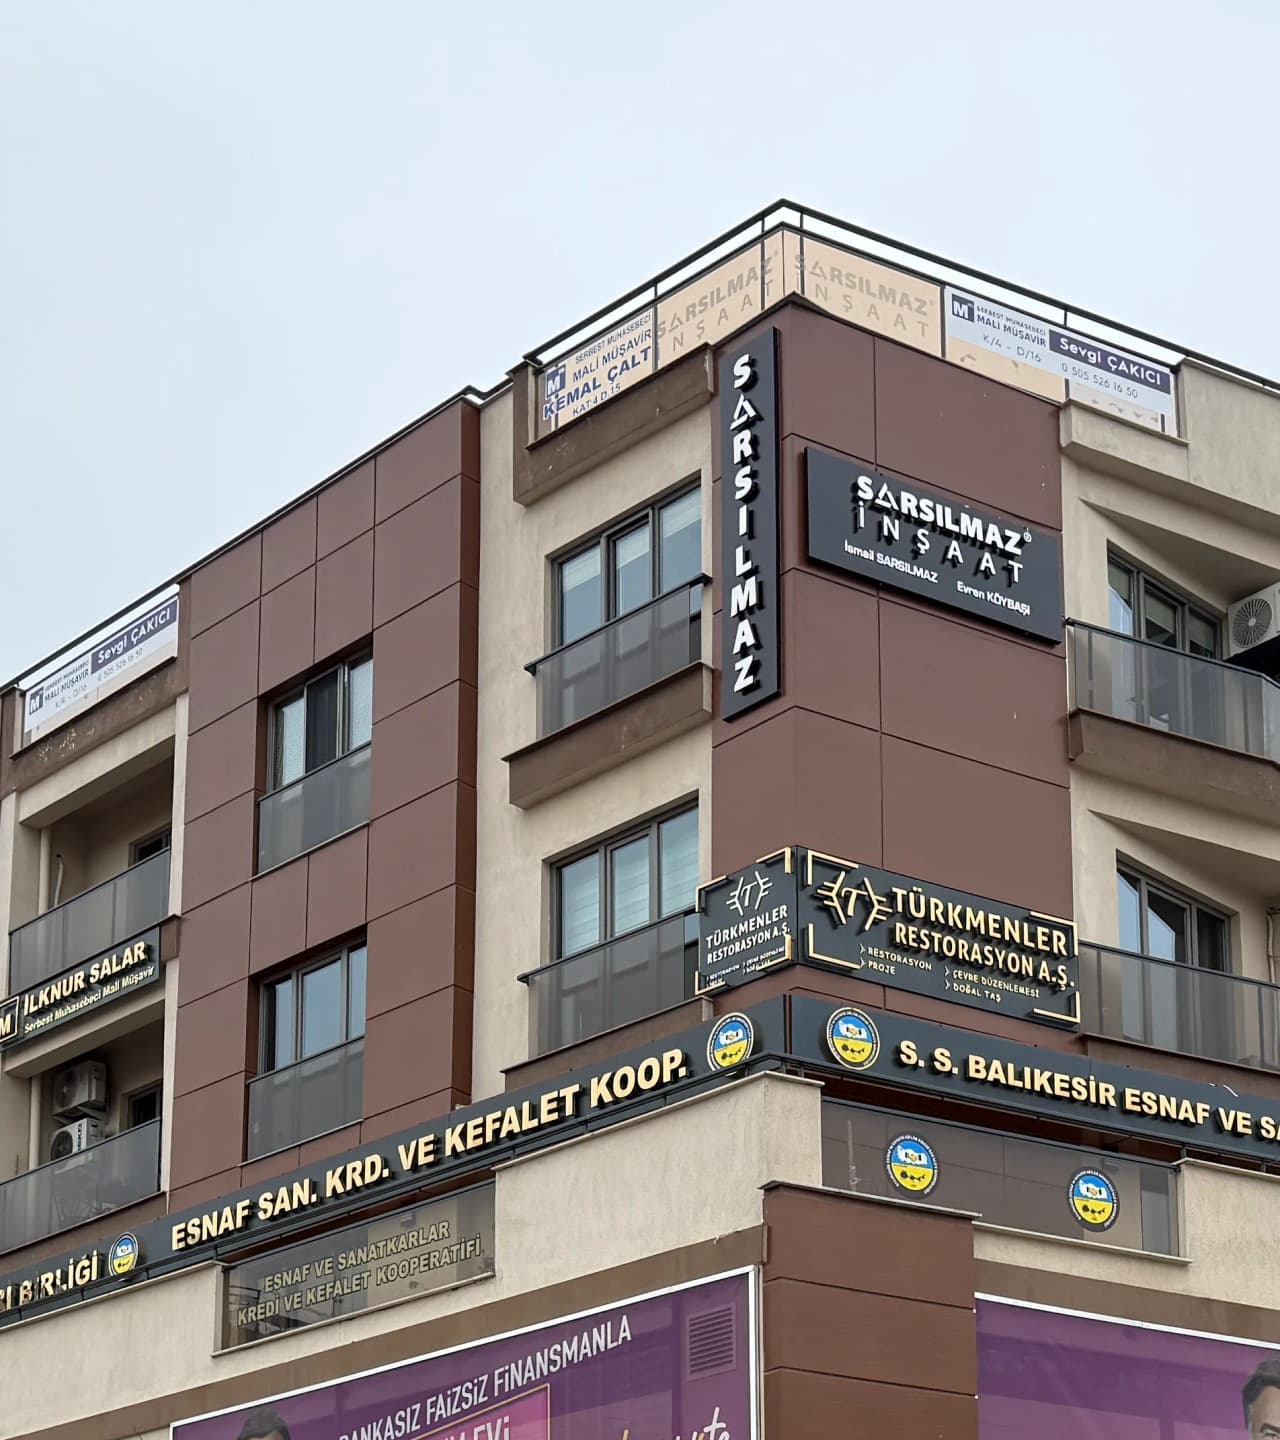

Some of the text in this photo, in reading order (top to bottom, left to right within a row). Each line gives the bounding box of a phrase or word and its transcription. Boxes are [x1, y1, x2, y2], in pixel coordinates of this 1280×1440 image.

[544, 346, 651, 420] KEMAL ÇALT
[1107, 355, 1161, 386] ÇAKICI
[730, 353, 757, 692] SARSILMAZ
[857, 475, 1023, 555] SARSILMAZ
[858, 501, 1024, 583] İNŞAAT
[876, 552, 938, 583] SARSILMAZ
[956, 580, 985, 601] Evren
[131, 607, 171, 644] ÇAKICI
[705, 904, 788, 950] TÜRKMENLER
[707, 930, 771, 965] RESTORASYON
[891, 887, 1067, 956] TÜRKMENLER
[89, 940, 146, 984] SALAR
[867, 946, 933, 972] RESTORASYON
[867, 960, 897, 976] PROJE
[894, 922, 1076, 992] RESTORASYON A.Ş.
[952, 969, 1041, 998] ÇEVRE DÜZENLEMESİ
[952, 981, 1003, 1004] DOĞAL TAŞ
[898, 1039, 926, 1068] S.
[933, 1048, 961, 1075] S.
[967, 1053, 1118, 1108] BALIKESİR
[1124, 1087, 1211, 1126] ESNAF
[1218, 1107, 1253, 1135] VE
[171, 1047, 688, 1252] ESNAF SAN. KRD. VE KEFALET KOOP.
[236, 1230, 483, 1328] KREDİ VE KEFALET KOOPERATİFİ
[264, 1218, 451, 1294] ESNAF VE SANATKARLAR
